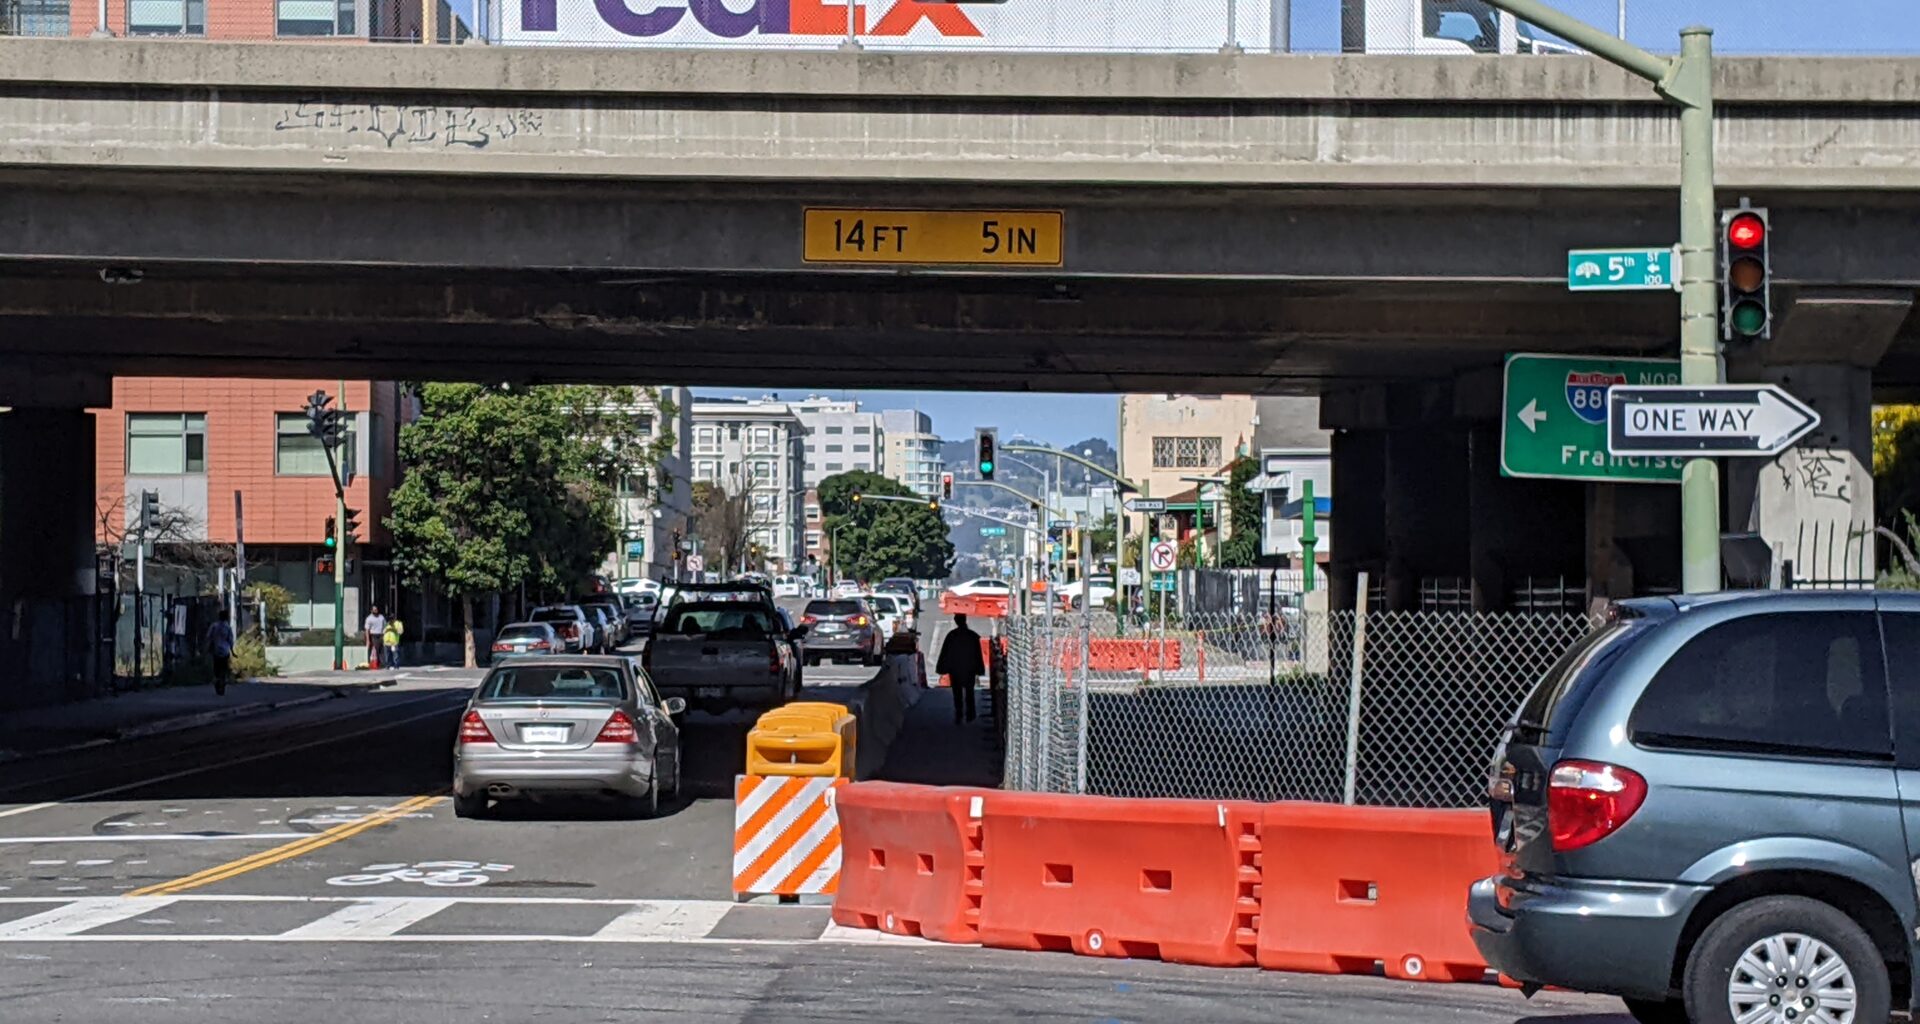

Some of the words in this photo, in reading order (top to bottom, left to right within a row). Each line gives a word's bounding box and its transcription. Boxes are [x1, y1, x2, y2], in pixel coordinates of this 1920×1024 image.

[834, 219, 865, 252] 14
[873, 226, 908, 252] FT
[982, 221, 1000, 253] 5
[1008, 228, 1036, 253] IN
[1608, 256, 1635, 281] 5th
[1573, 389, 1607, 409] 88
[1632, 409, 1686, 431] ONE
[1699, 409, 1754, 431] WAY
[1561, 445, 1683, 469] Francisc
